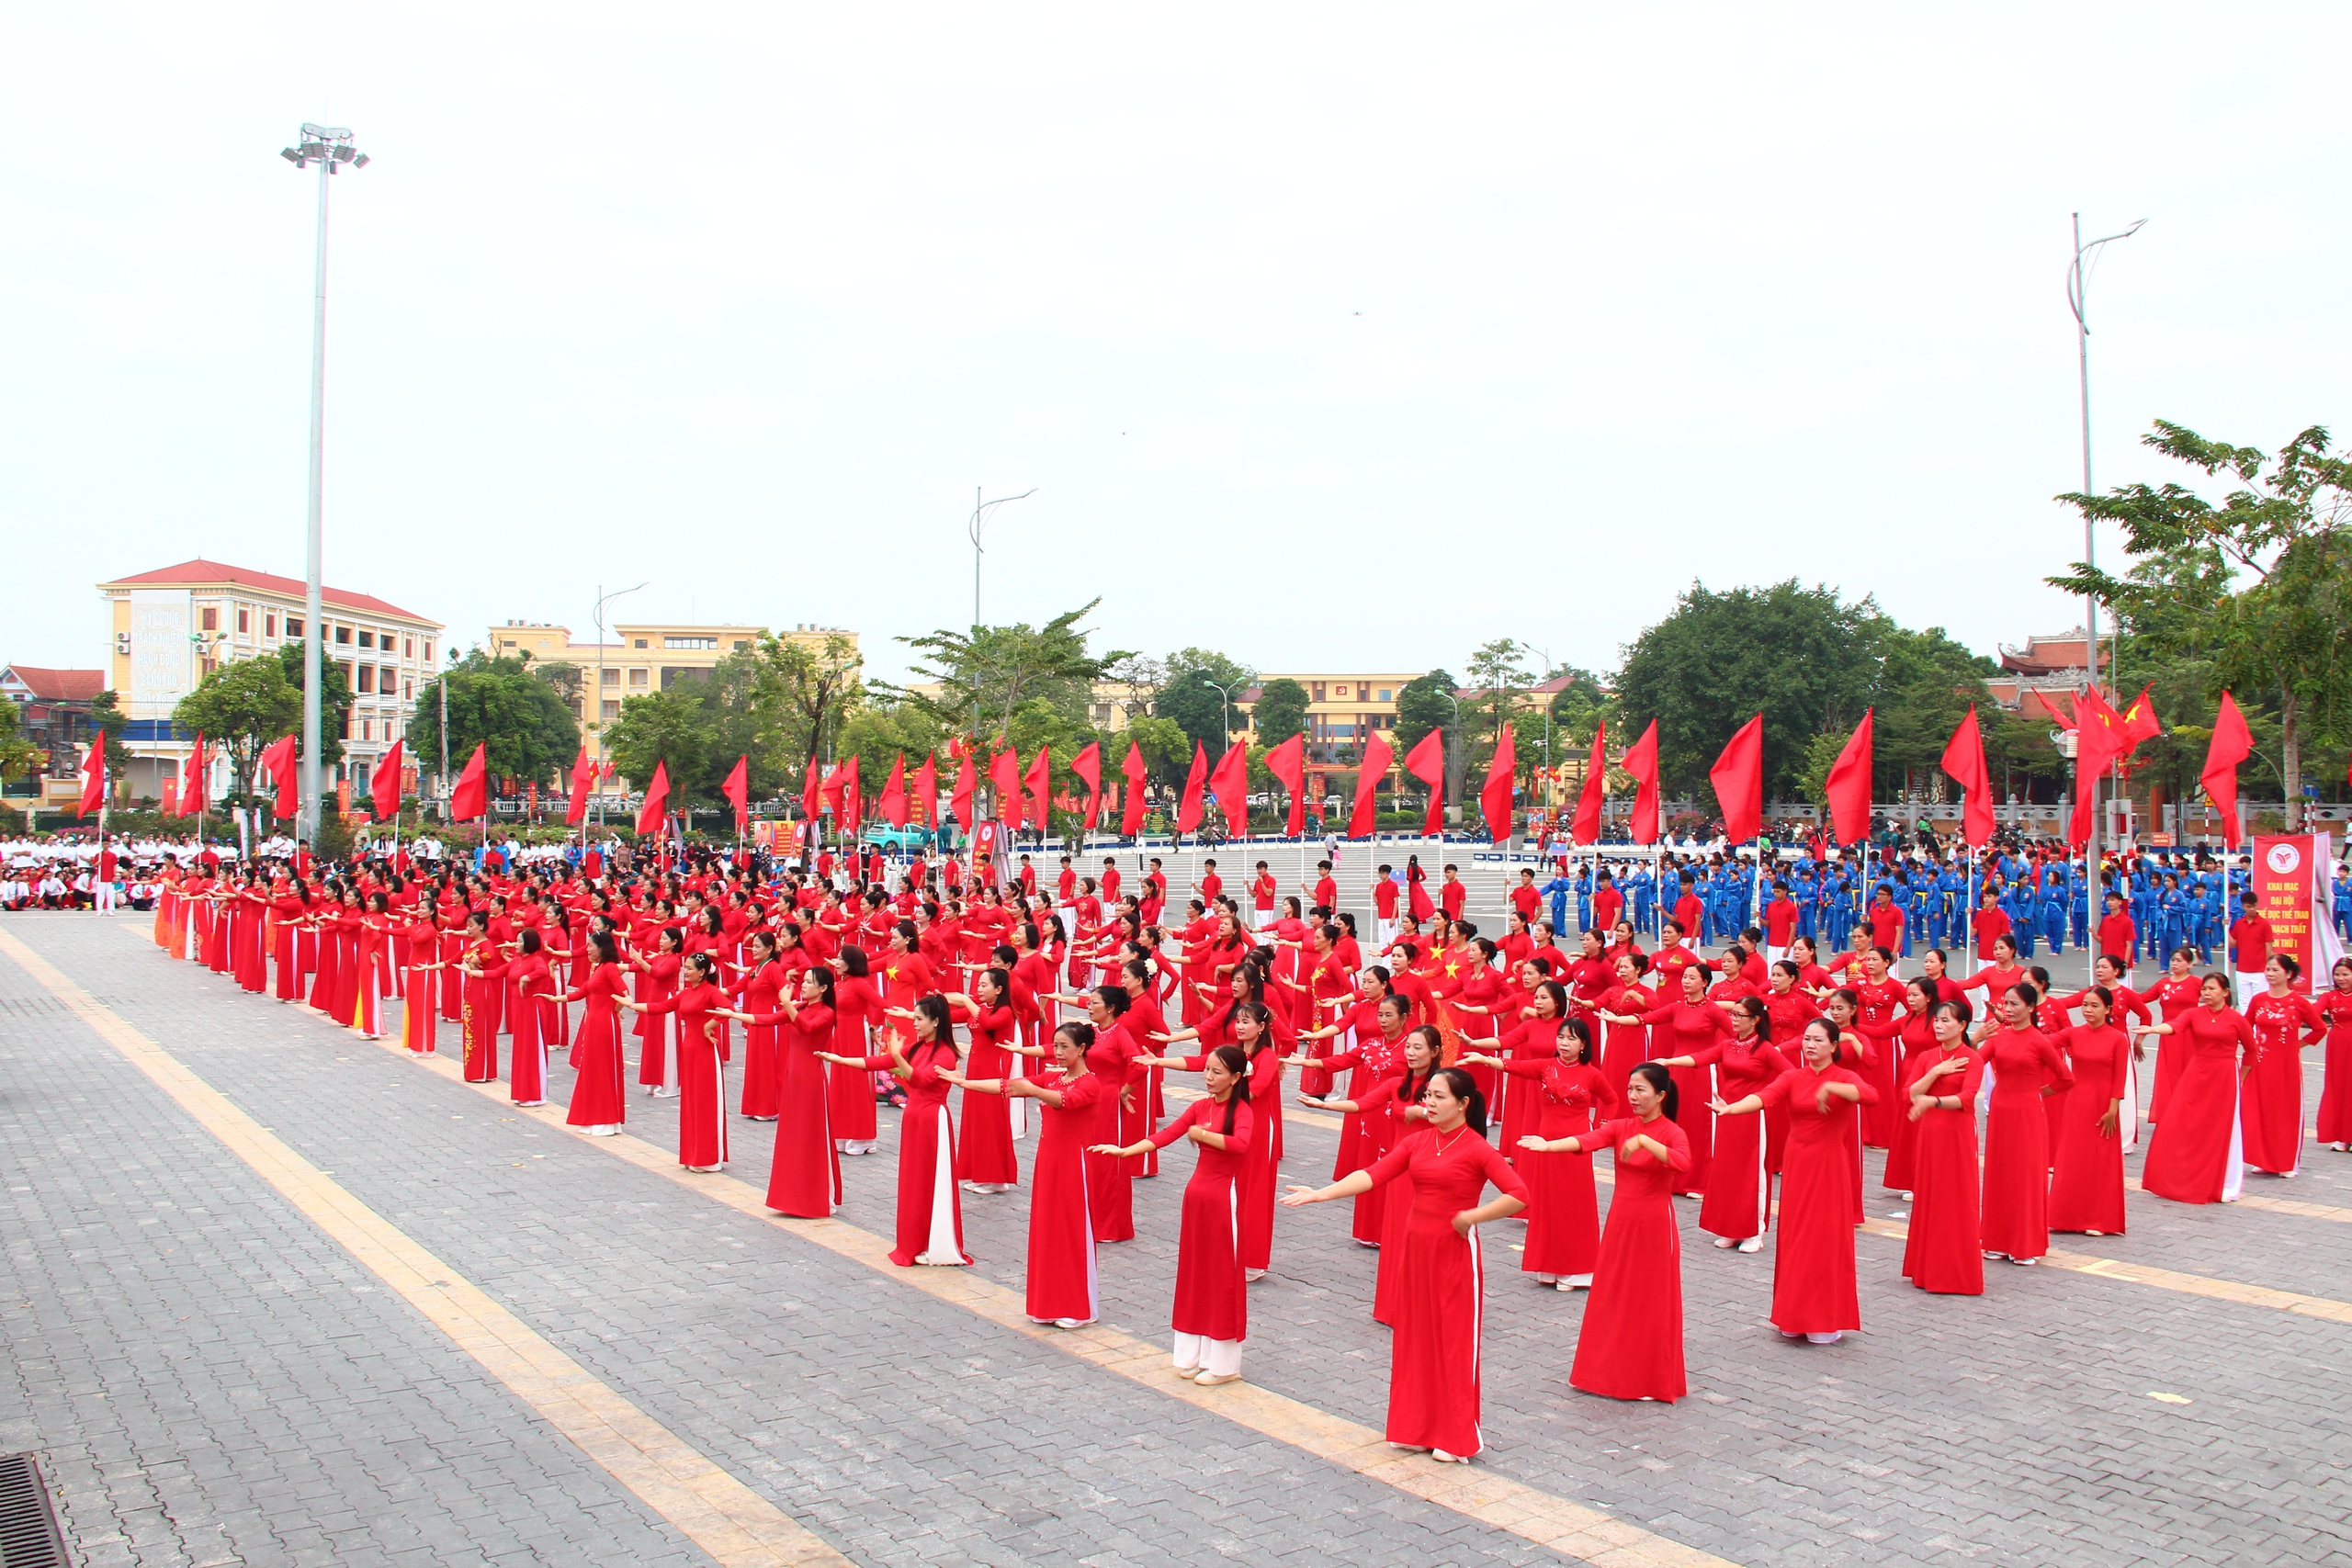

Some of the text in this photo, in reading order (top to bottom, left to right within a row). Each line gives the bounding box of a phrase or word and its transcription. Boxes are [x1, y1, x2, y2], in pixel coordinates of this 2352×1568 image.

[2267, 882, 2299, 893] KHAI MẠC
[2270, 895, 2294, 908] ĐẠI HỘI
[2267, 910, 2281, 921] DỤC
[2294, 910, 2309, 919] THAO
[2271, 924, 2290, 935] HẠCH
